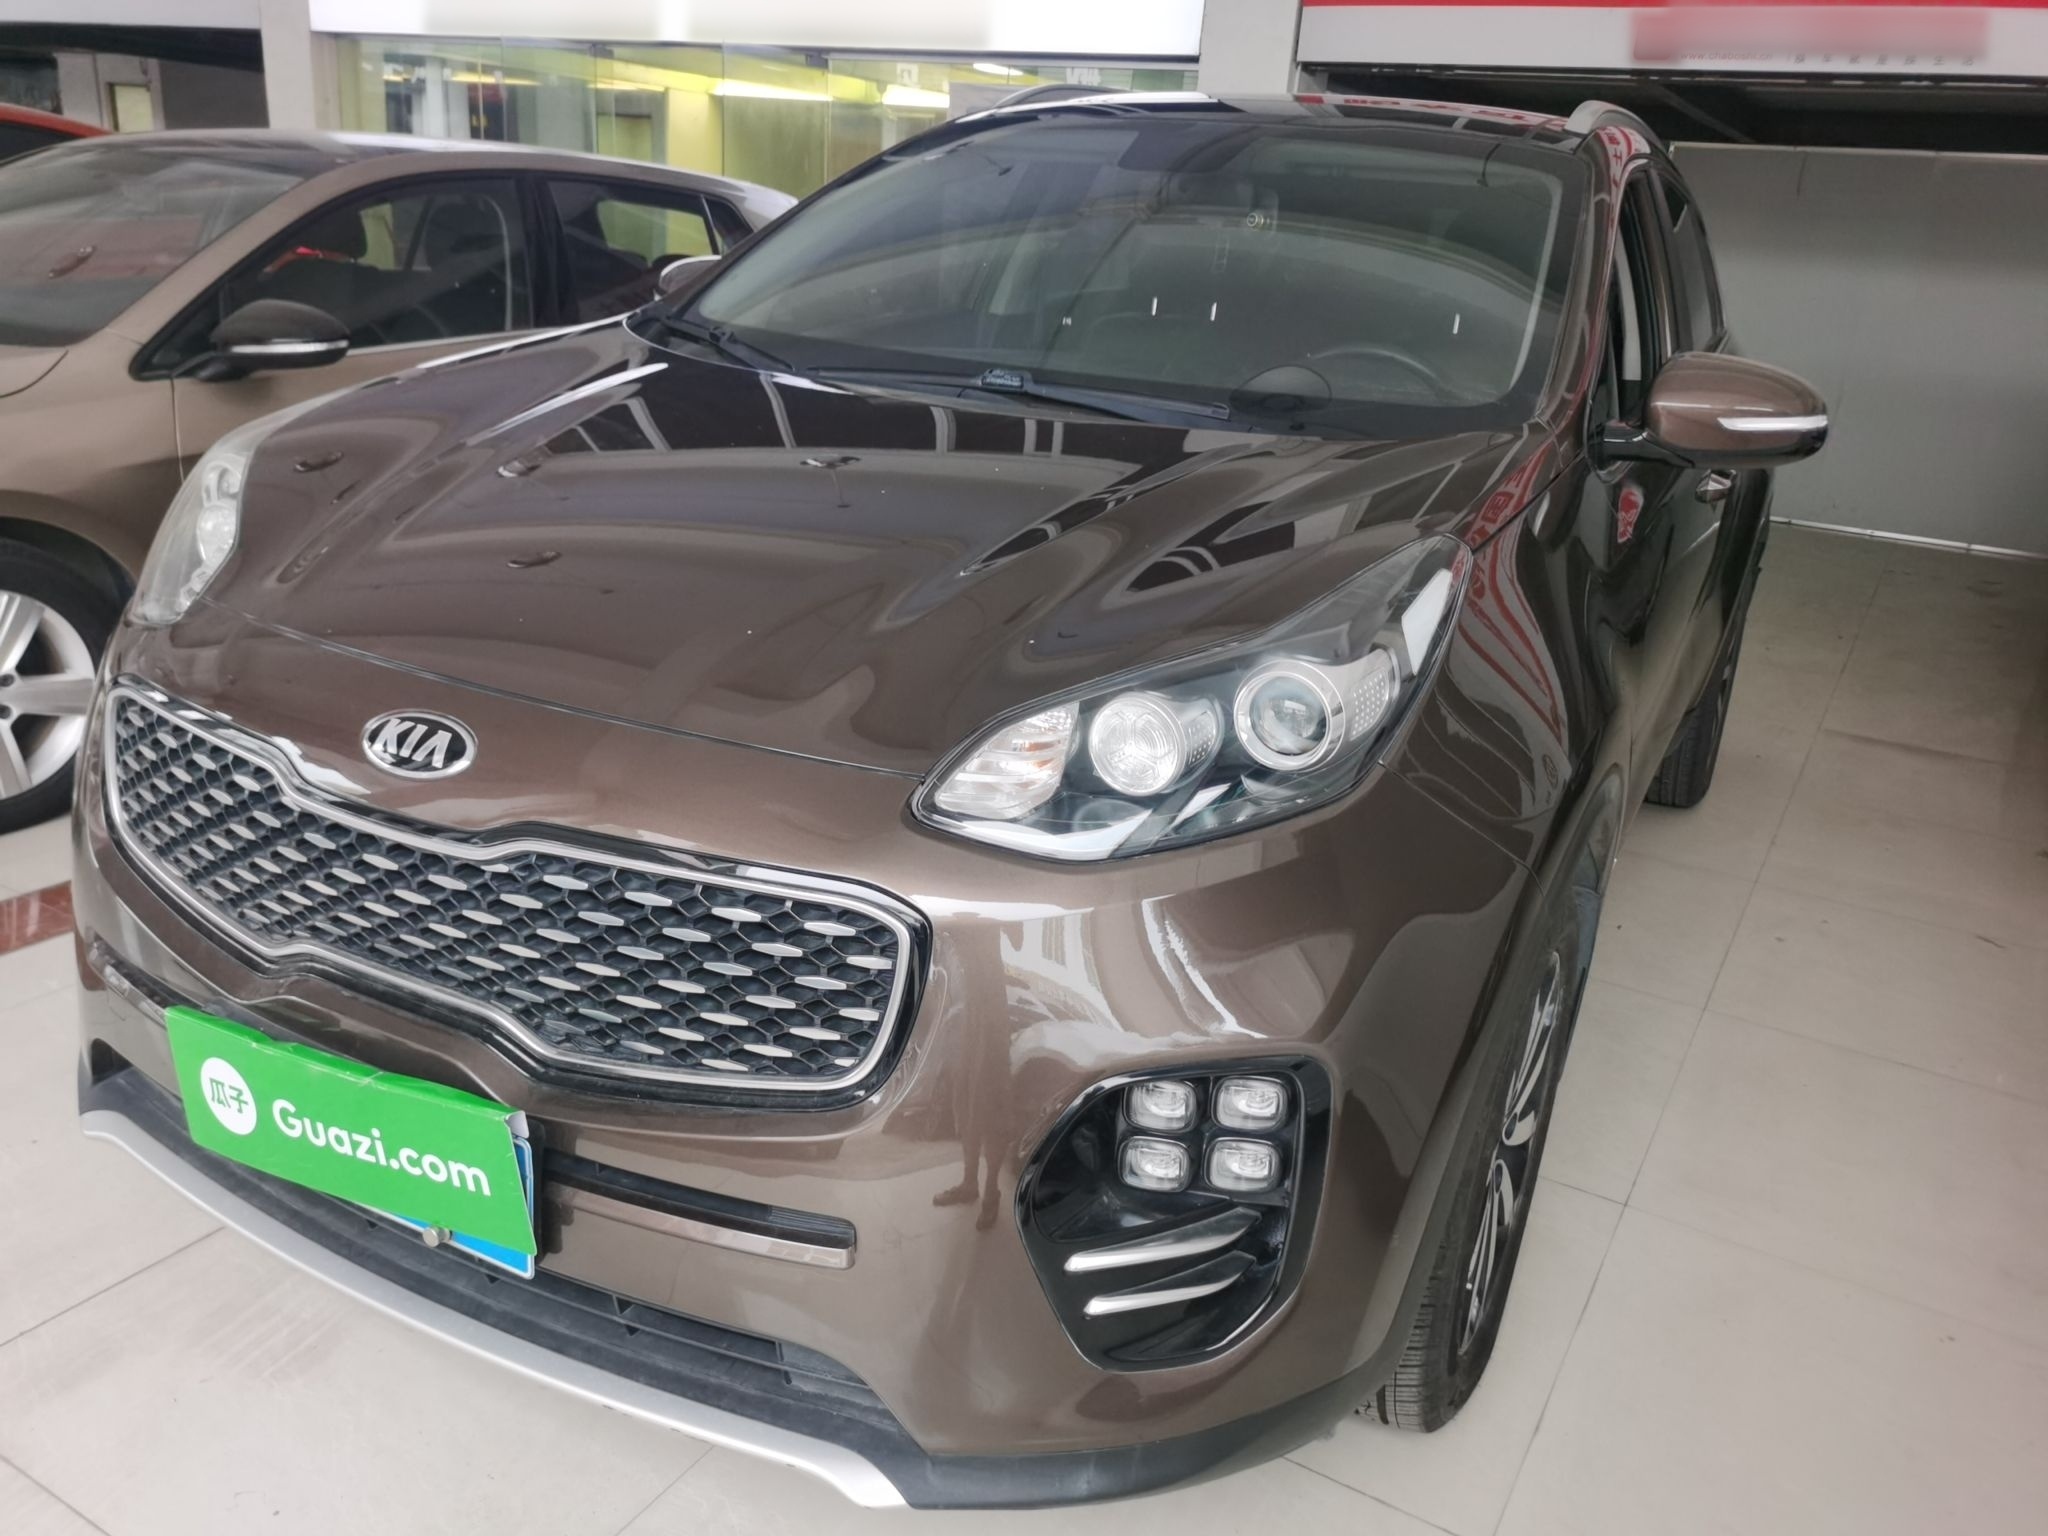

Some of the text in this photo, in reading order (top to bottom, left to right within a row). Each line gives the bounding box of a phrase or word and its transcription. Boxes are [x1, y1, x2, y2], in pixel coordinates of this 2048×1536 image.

[370, 717, 453, 769] KIA
[208, 1077, 249, 1114] 瓜子
[272, 1099, 491, 1196] Guazi.com
